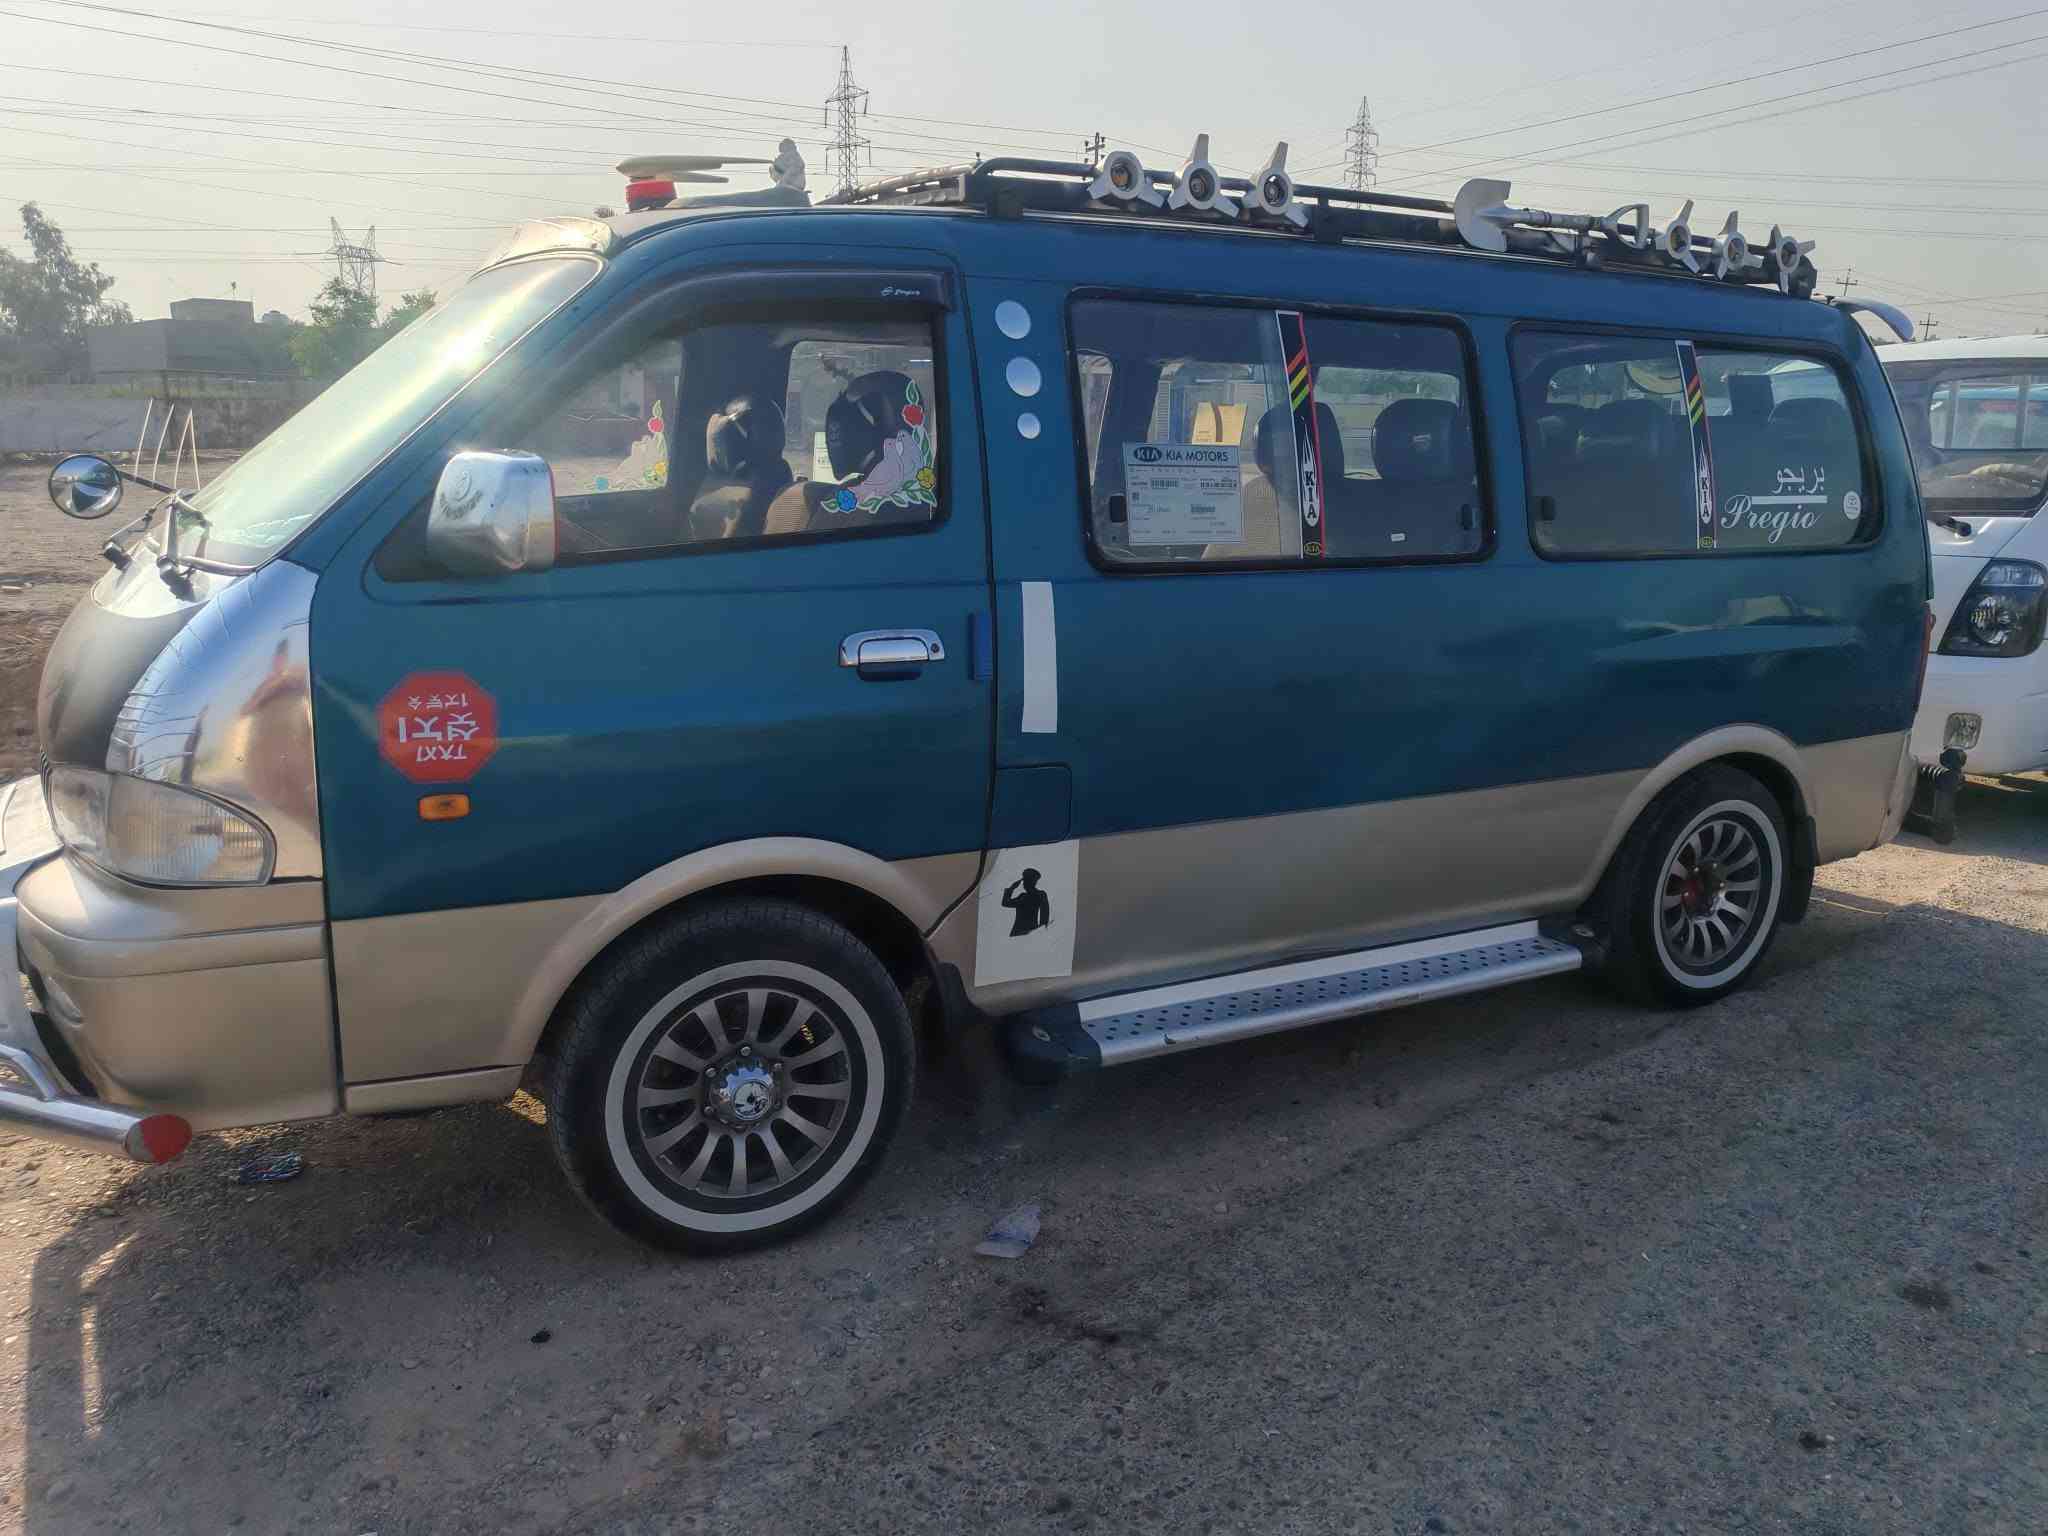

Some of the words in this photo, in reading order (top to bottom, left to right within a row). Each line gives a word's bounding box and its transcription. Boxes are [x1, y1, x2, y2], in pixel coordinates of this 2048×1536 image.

[1135, 447, 1161, 461] KIA
[1166, 450, 1183, 461] KIA
[1186, 451, 1229, 462] MOTORS
[1305, 471, 1317, 518] KIA
[1701, 477, 1710, 517] KIA
[1720, 494, 1822, 544] Pregio
[416, 743, 468, 762] TAXI
